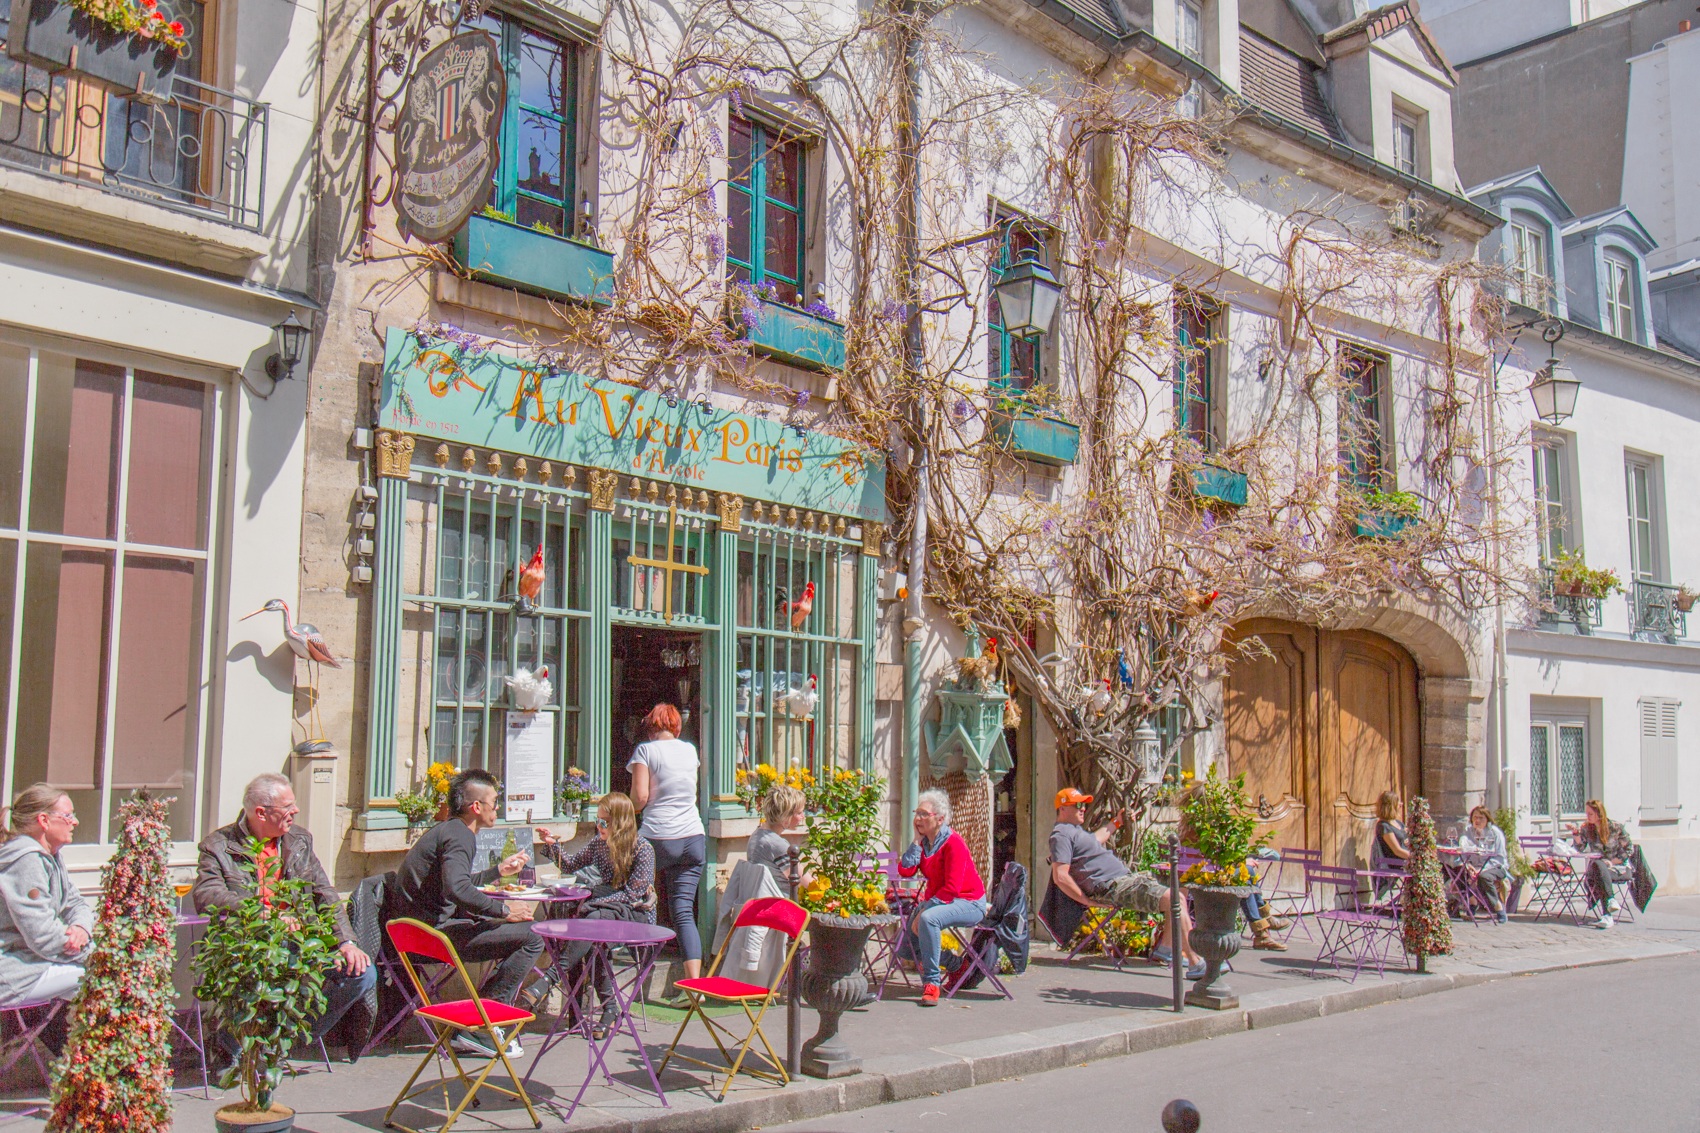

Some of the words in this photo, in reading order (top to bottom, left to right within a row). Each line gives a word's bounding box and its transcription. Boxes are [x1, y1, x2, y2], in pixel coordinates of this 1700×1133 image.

[505, 366, 577, 427] Au
[584, 382, 702, 452] Vieux
[711, 418, 807, 473] Paris
[632, 448, 706, 481] d'Arcole
